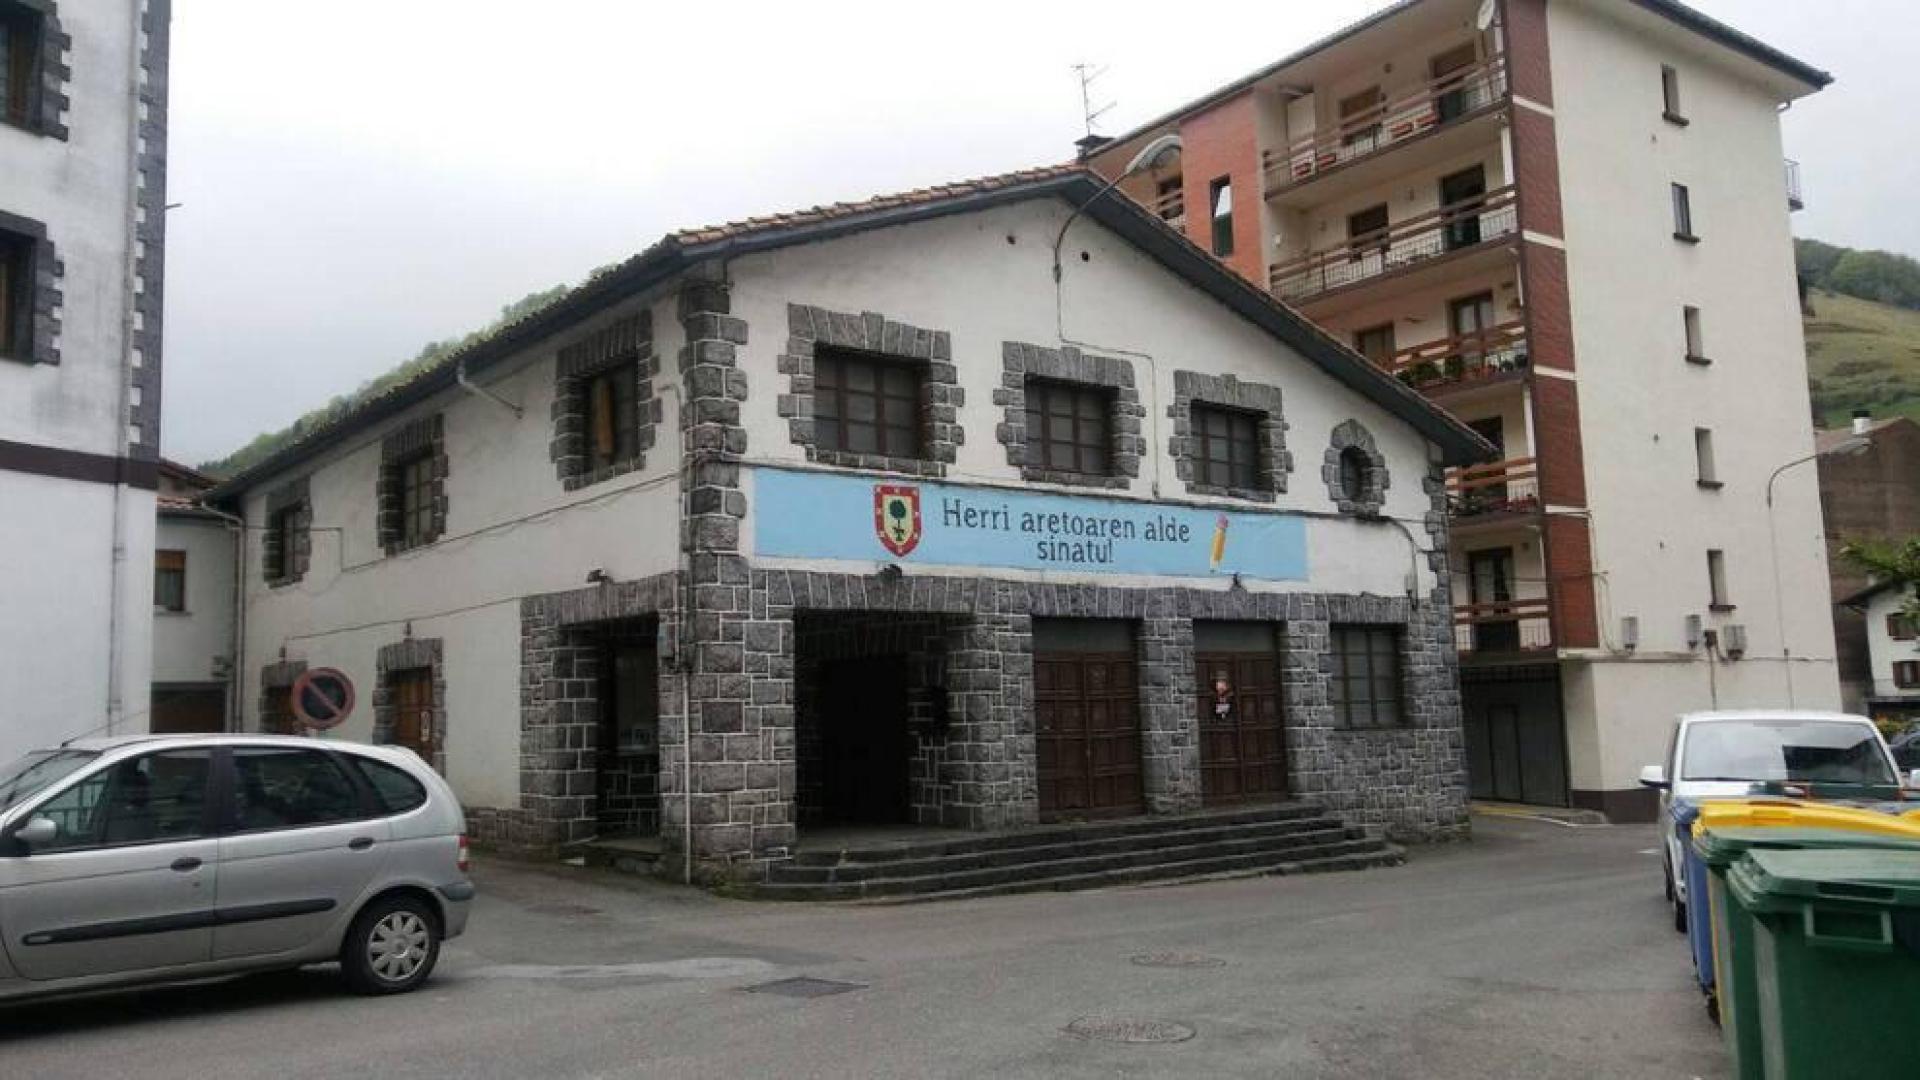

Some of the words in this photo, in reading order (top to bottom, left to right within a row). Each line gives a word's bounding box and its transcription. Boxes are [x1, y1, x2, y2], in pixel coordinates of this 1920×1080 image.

[943, 498, 1010, 531] Herri
[1021, 511, 1136, 539] aretoaren
[1143, 514, 1190, 544] alde
[1037, 535, 1113, 564] sinatu!
